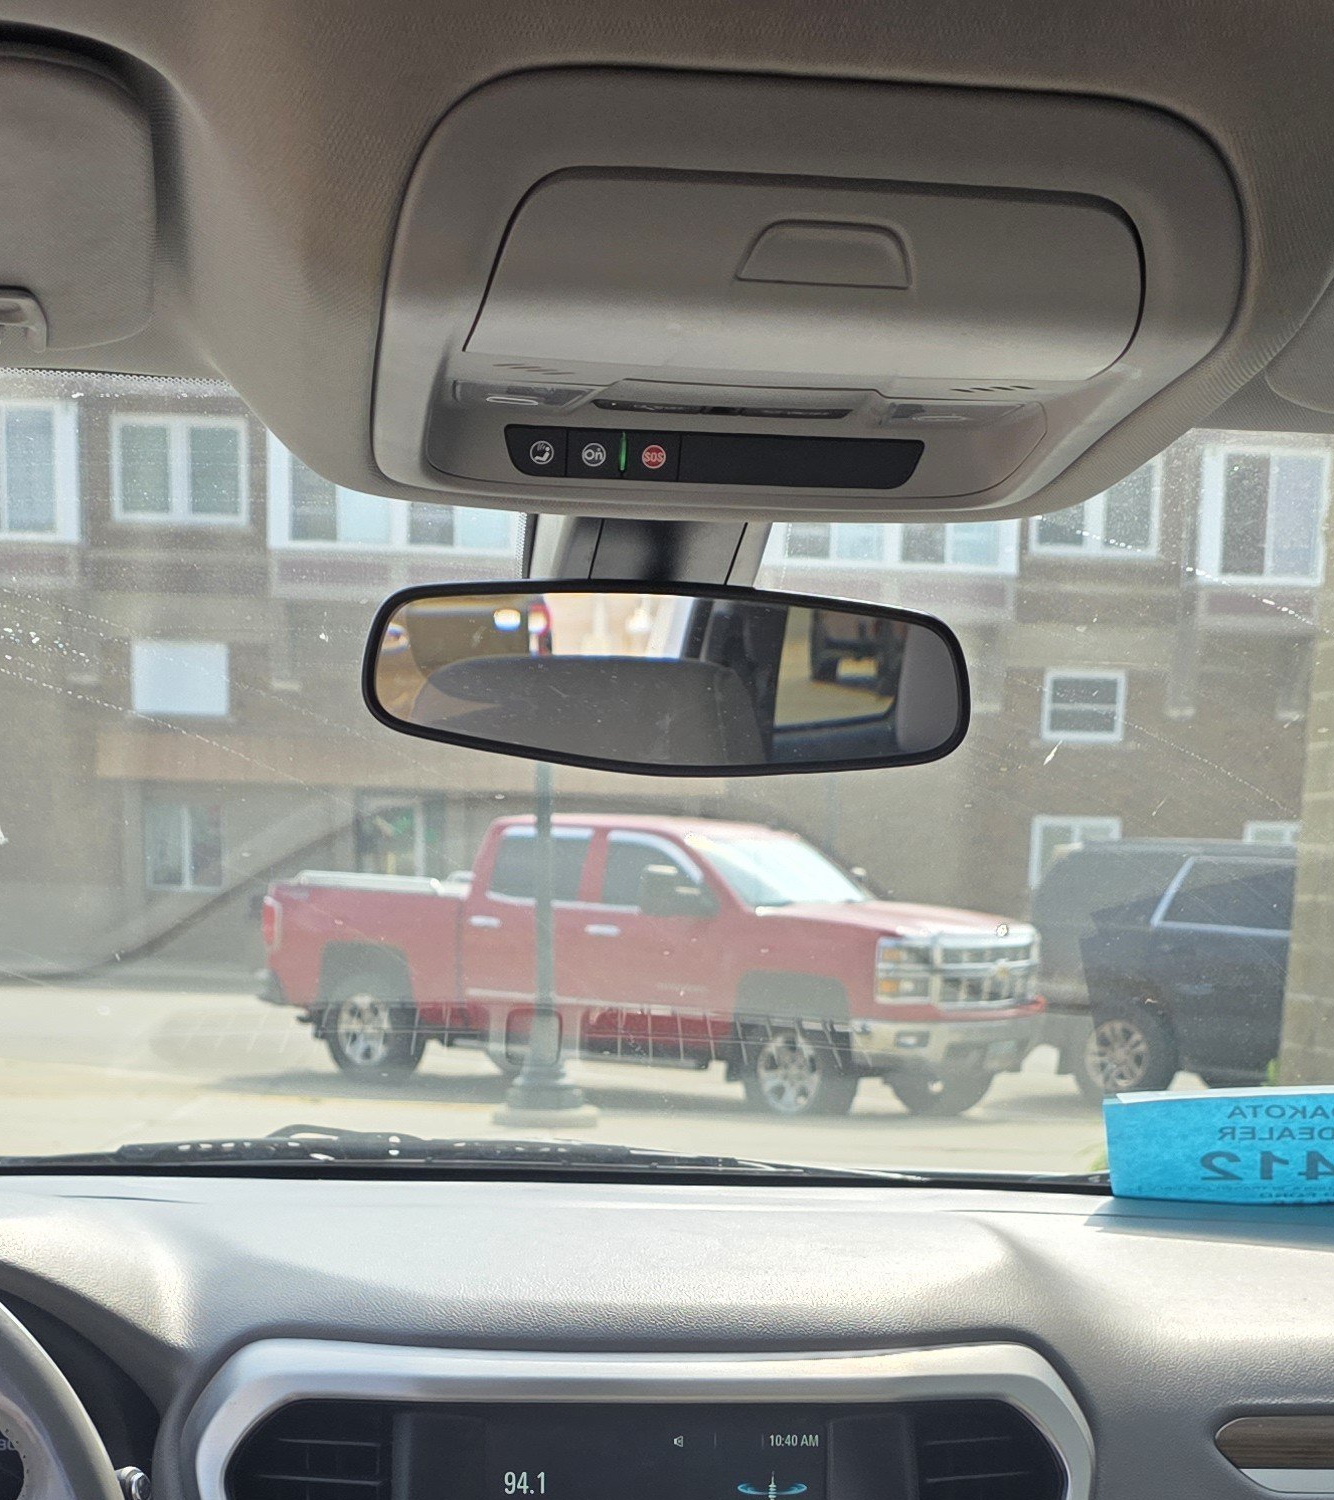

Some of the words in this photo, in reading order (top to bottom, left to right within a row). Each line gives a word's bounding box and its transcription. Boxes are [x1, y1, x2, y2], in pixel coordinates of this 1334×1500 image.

[643, 451, 665, 463] SOS
[769, 1433, 799, 1447] 10:40
[800, 1433, 820, 1448] AM
[503, 1471, 546, 1495] 94.1
